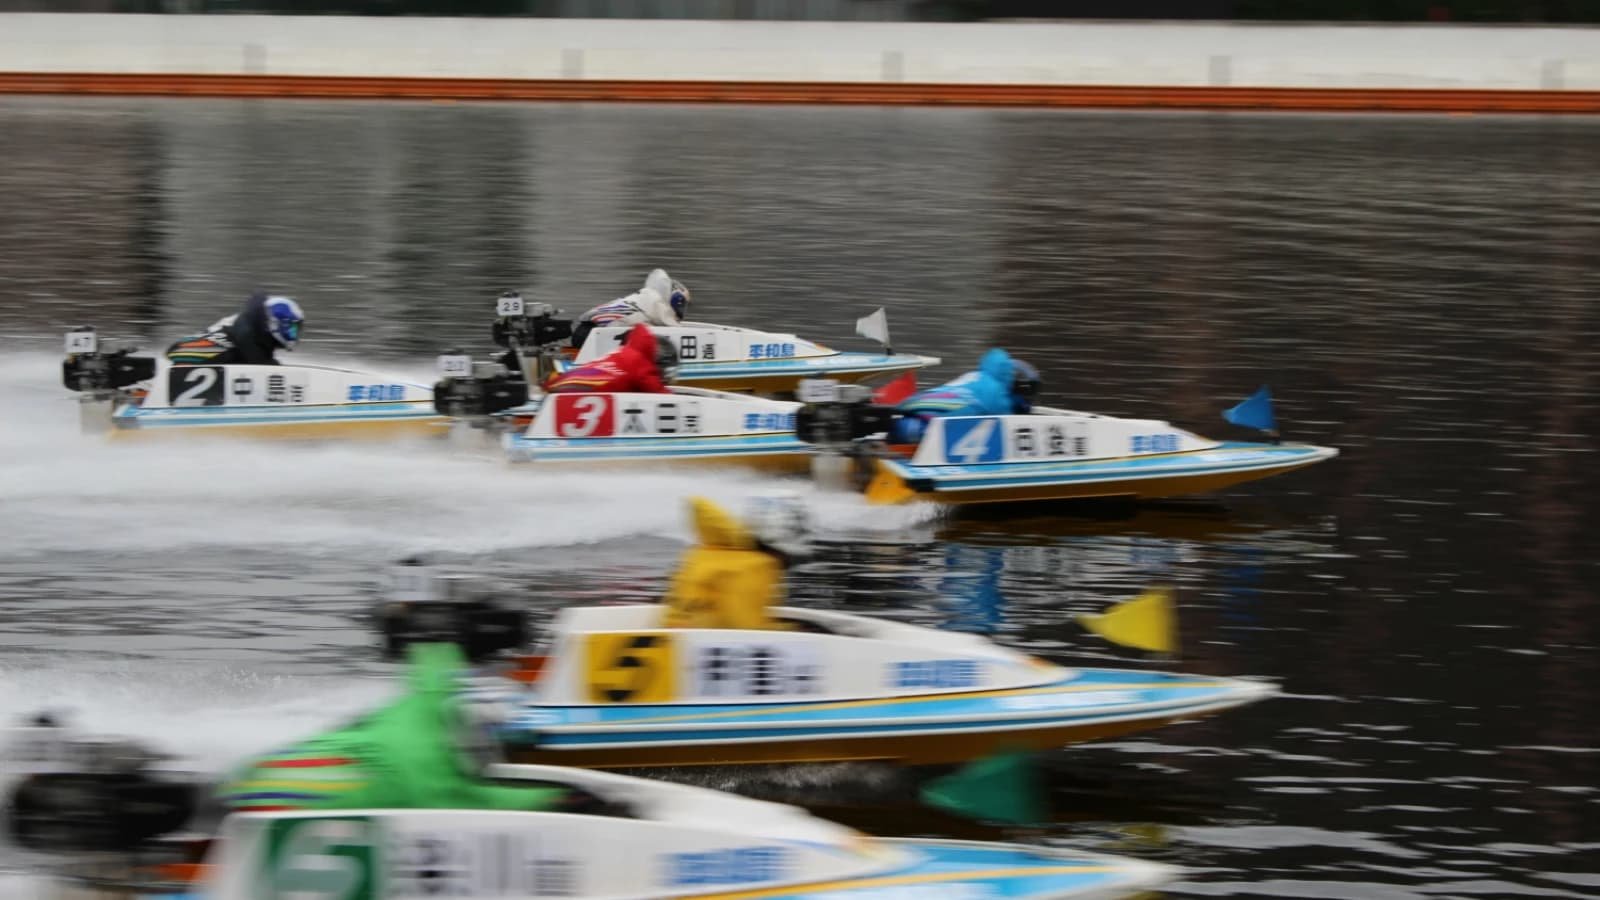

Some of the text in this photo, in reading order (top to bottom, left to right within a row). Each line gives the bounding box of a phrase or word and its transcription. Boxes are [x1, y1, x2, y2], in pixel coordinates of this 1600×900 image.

[503, 301, 520, 312] 29
[749, 343, 796, 358] 平和島
[175, 367, 218, 405] 2
[560, 396, 608, 437] 3
[948, 418, 997, 462] 4
[593, 635, 667, 702] 5
